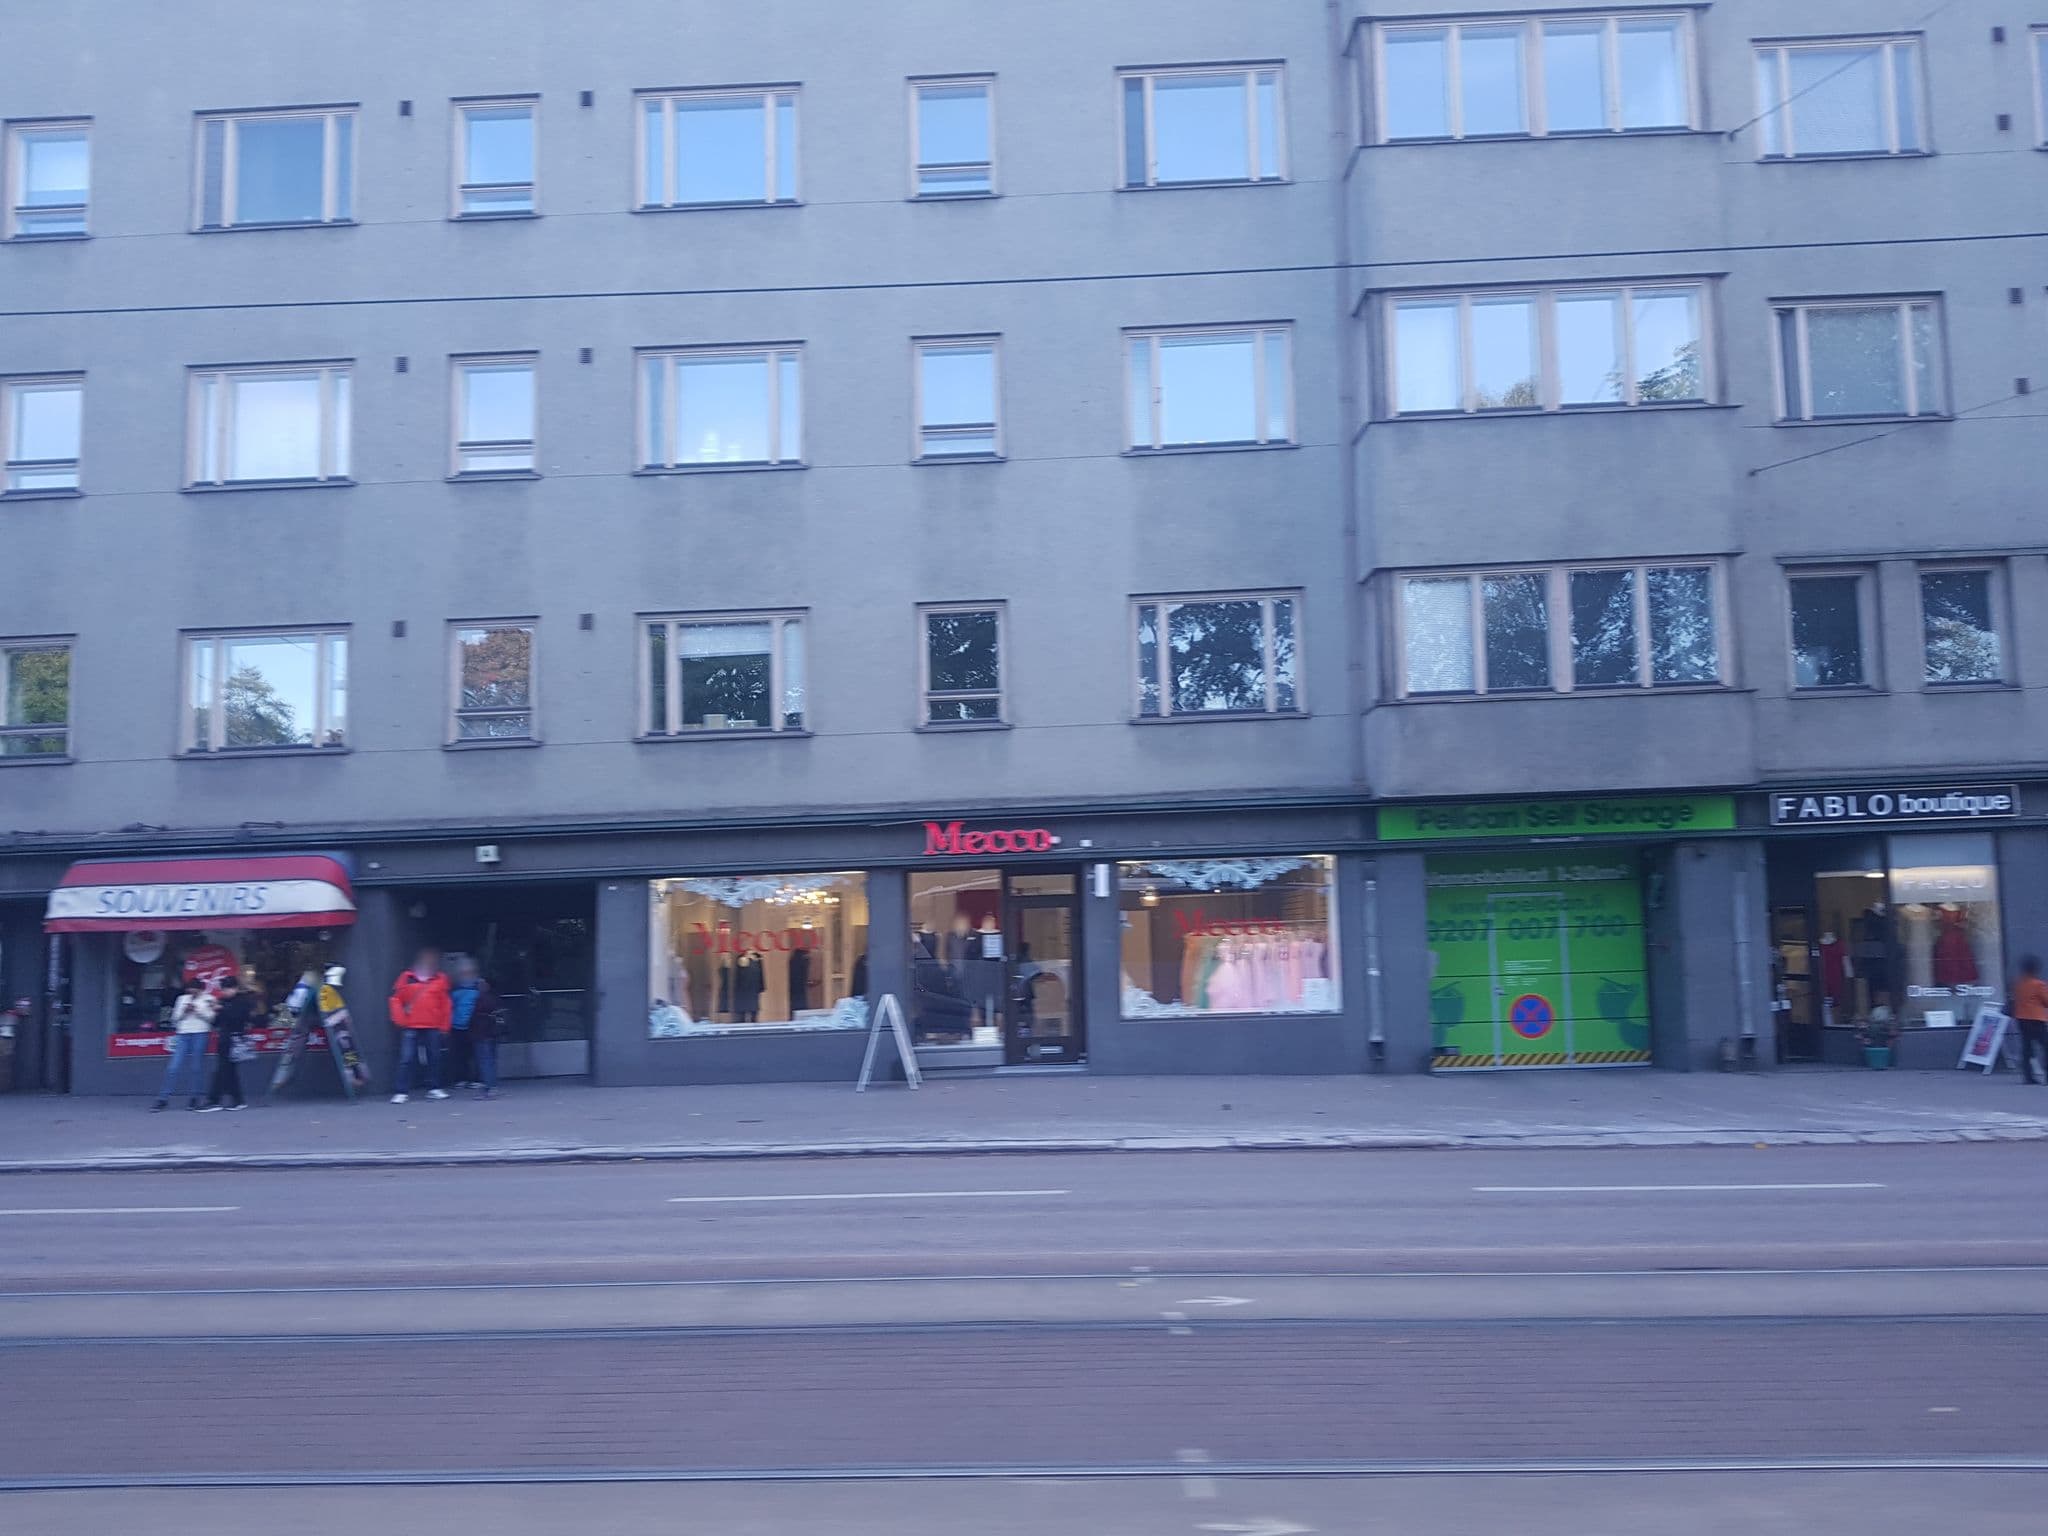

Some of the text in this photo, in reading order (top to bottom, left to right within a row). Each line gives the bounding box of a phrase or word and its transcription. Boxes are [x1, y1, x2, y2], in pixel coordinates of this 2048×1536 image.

[1526, 804, 1577, 829] Self
[1584, 801, 1695, 830] Storage
[1777, 792, 2012, 818] FABLO boutique
[922, 821, 1052, 855] Mecco
[96, 886, 269, 914] SOUVENIRS
